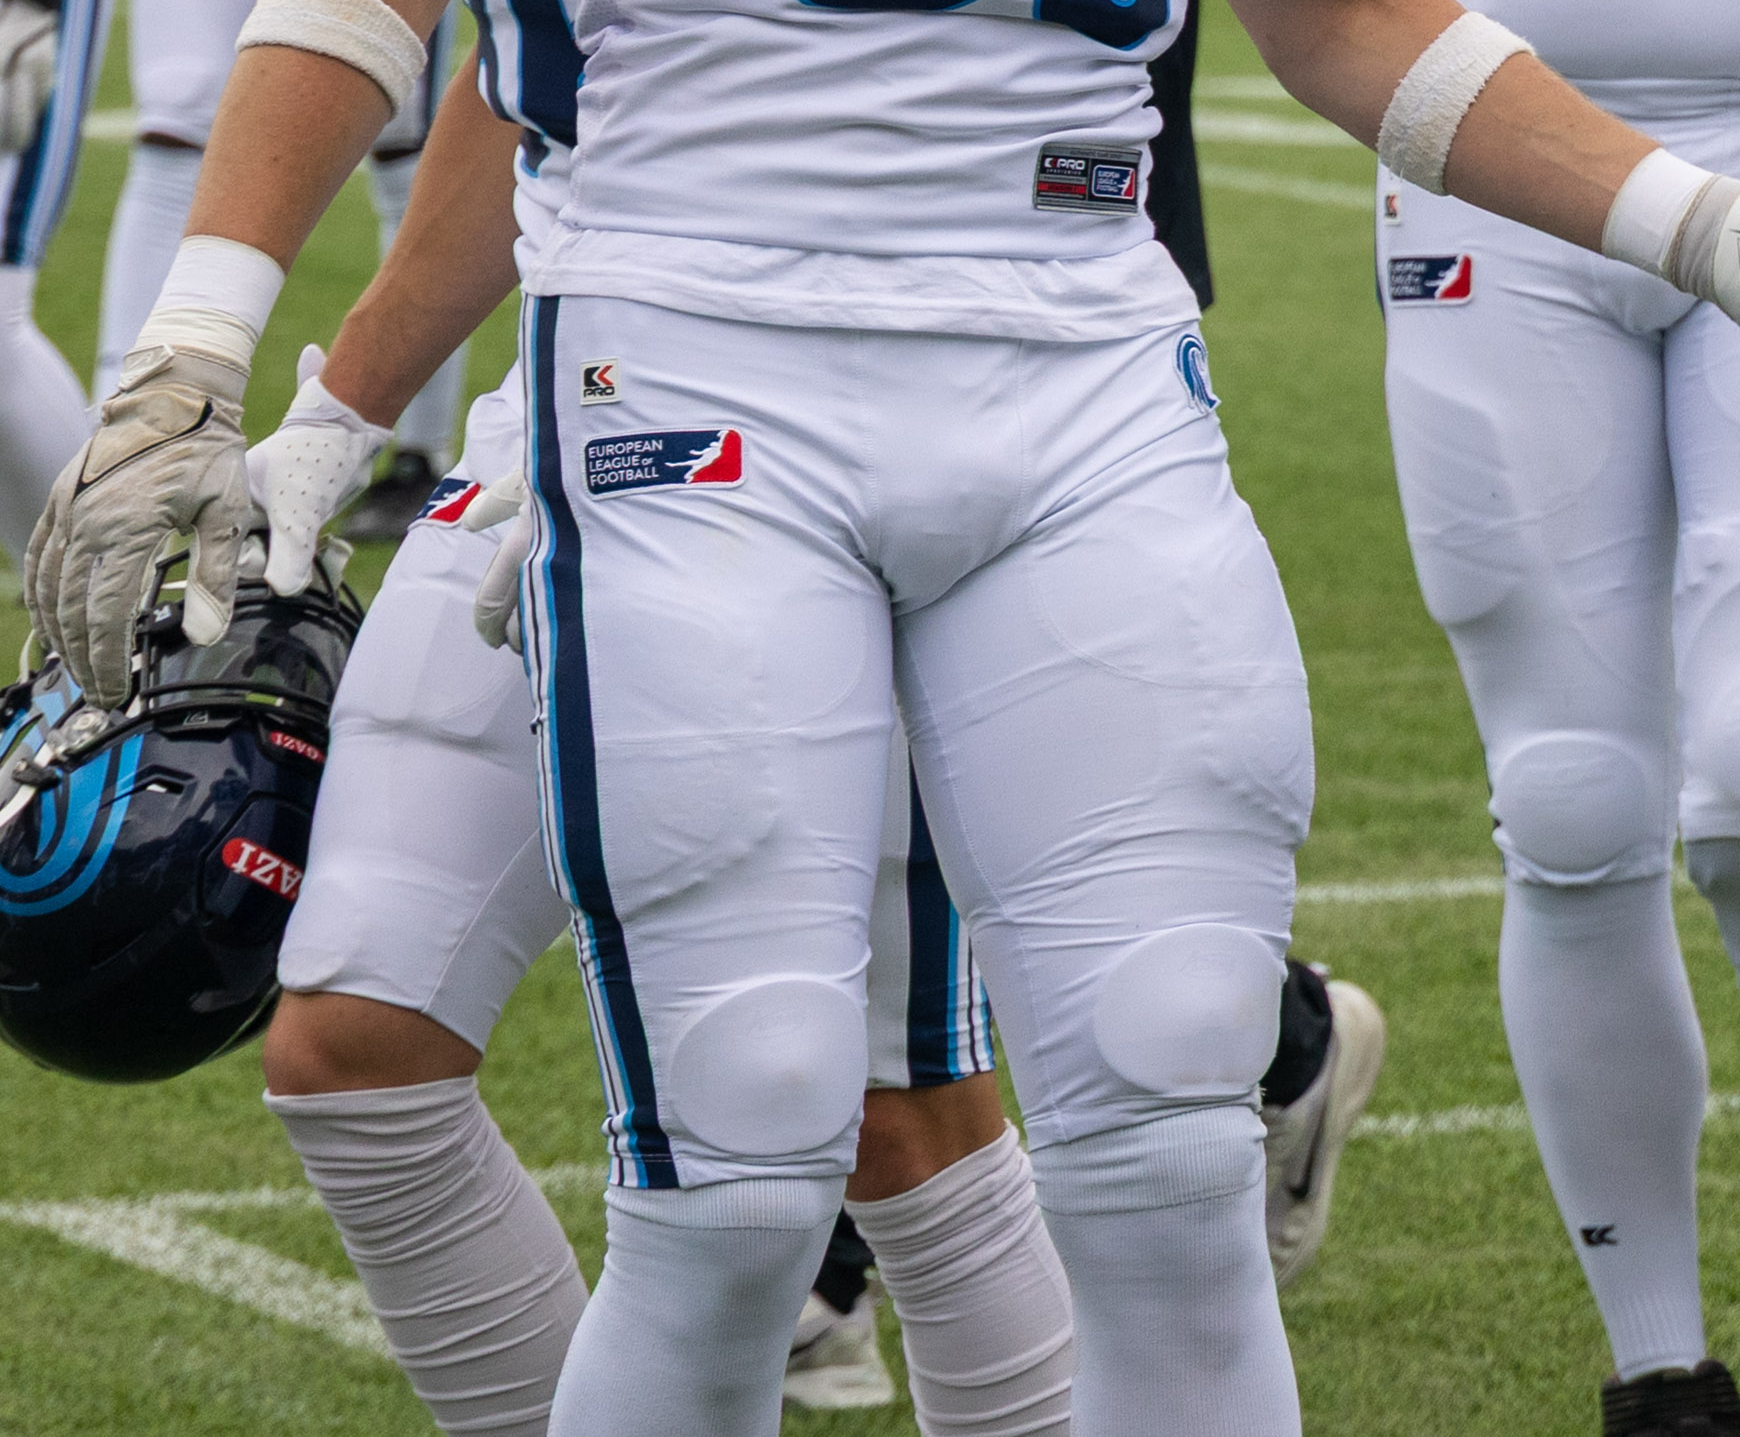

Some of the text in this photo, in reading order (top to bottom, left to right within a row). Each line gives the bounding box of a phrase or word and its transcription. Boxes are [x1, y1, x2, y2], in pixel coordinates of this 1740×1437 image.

[588, 439, 664, 459] EUROPEAN
[588, 454, 641, 473] LEAGUE
[589, 466, 660, 487] FOOTBALL
